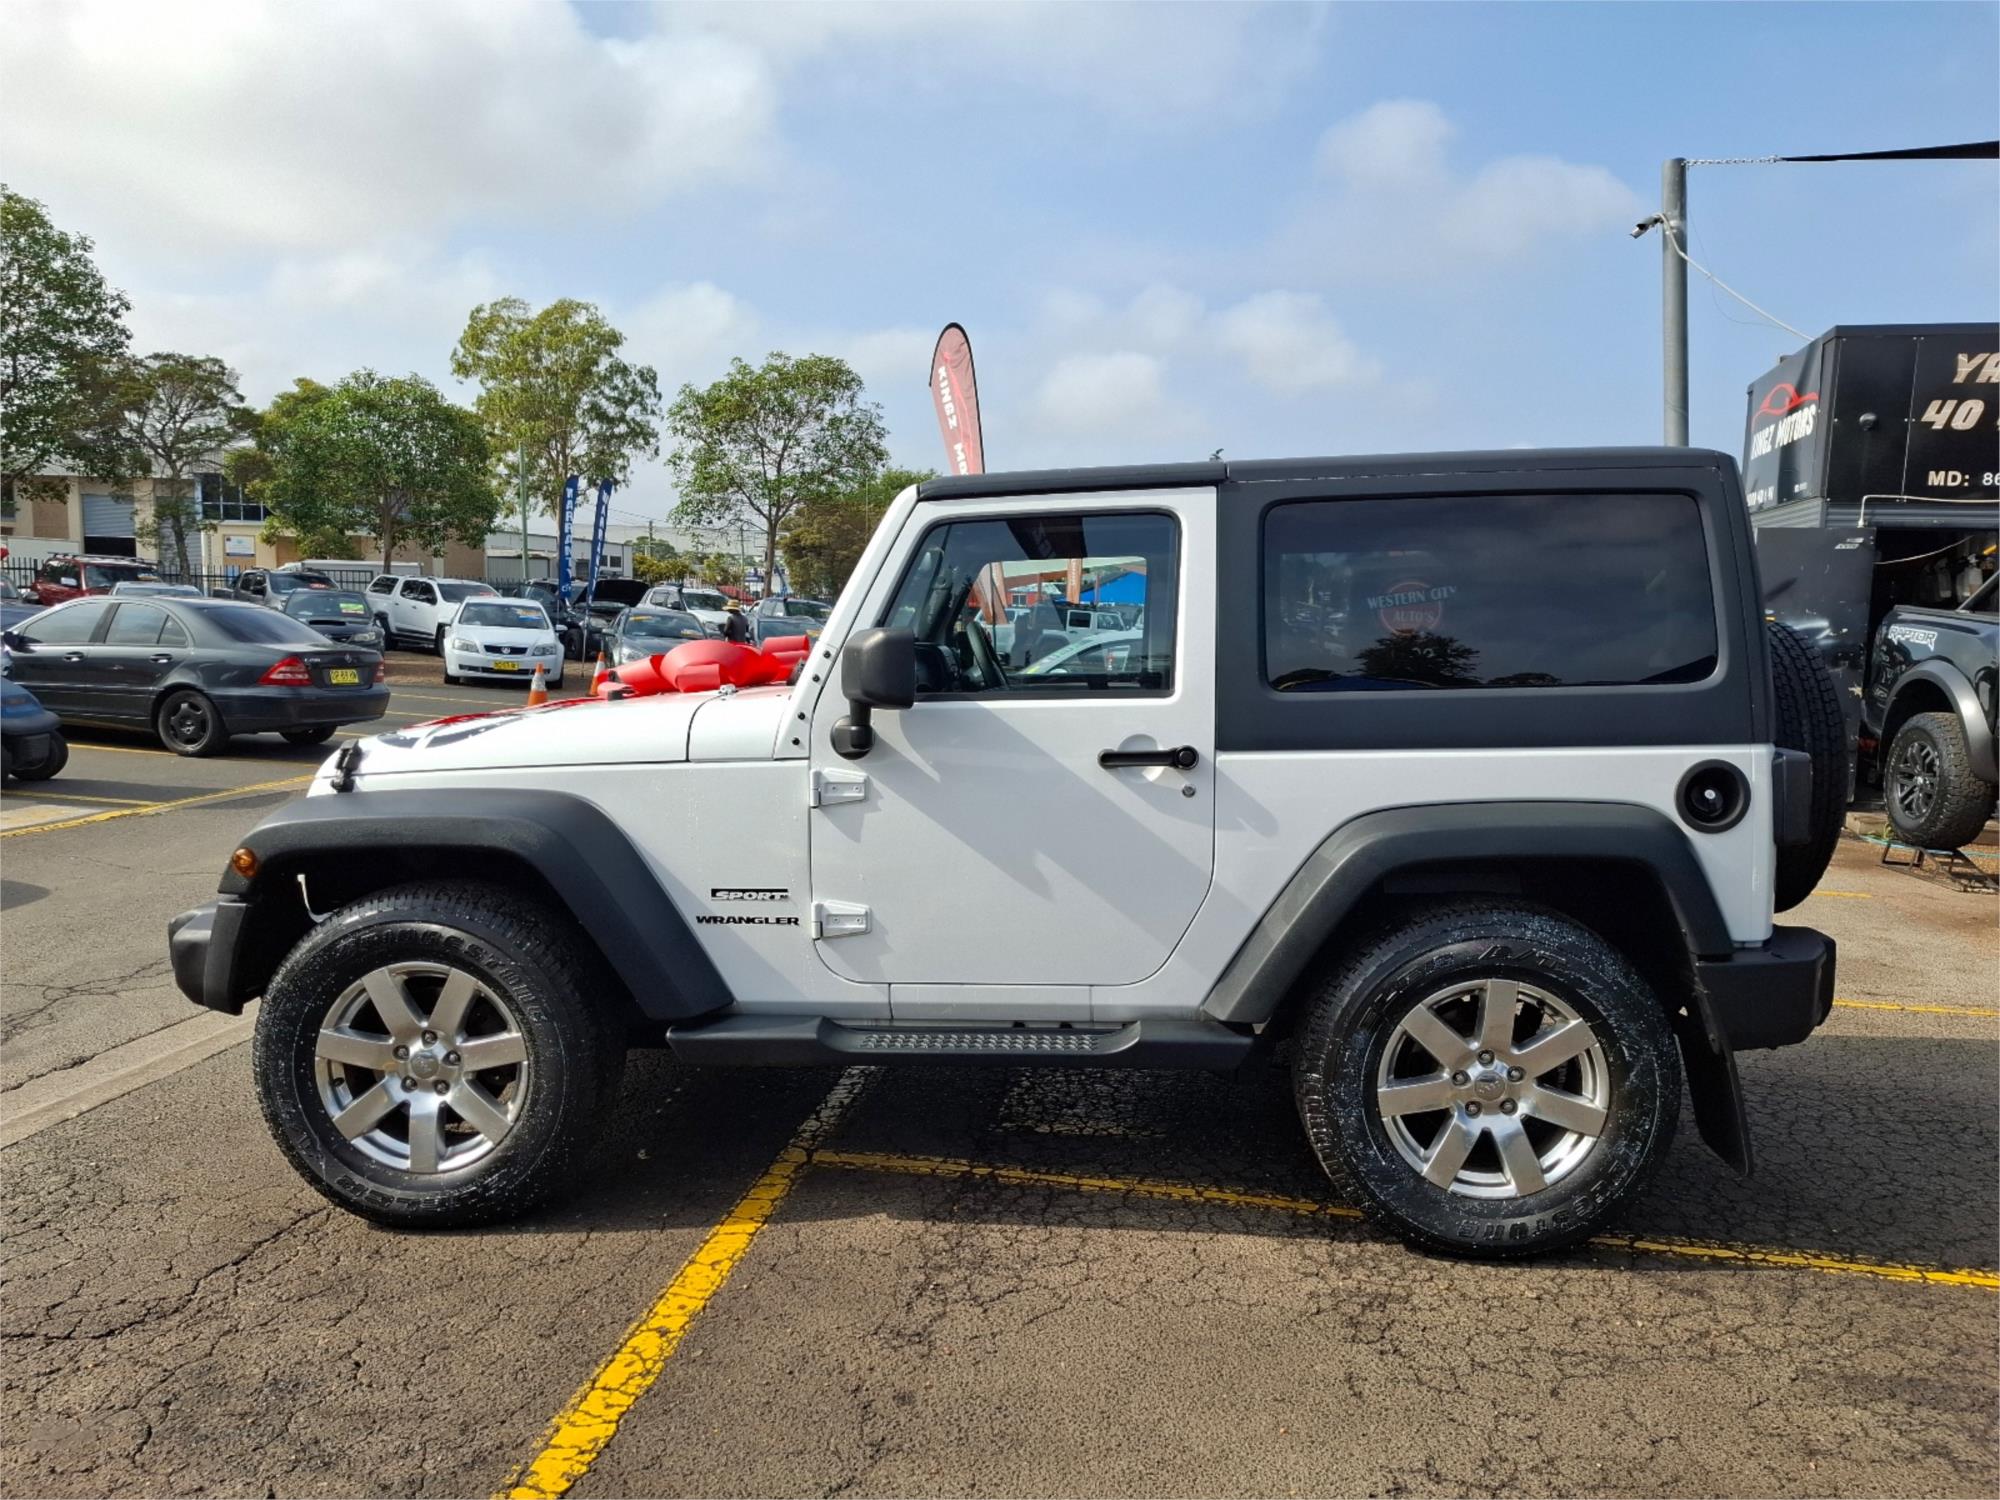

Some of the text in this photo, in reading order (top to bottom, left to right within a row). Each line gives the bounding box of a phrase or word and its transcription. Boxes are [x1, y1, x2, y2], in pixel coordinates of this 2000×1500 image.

[938, 365, 958, 430] KINGZ
[1775, 403, 1817, 449] MOTORS
[1920, 399, 1985, 431] 40
[1927, 469, 1970, 487] MD:
[1367, 585, 1457, 610] WESTERN CITY
[1887, 624, 1938, 650] RAPTOR
[713, 889, 787, 901] SPORT
[696, 915, 800, 926] WRANGLER
